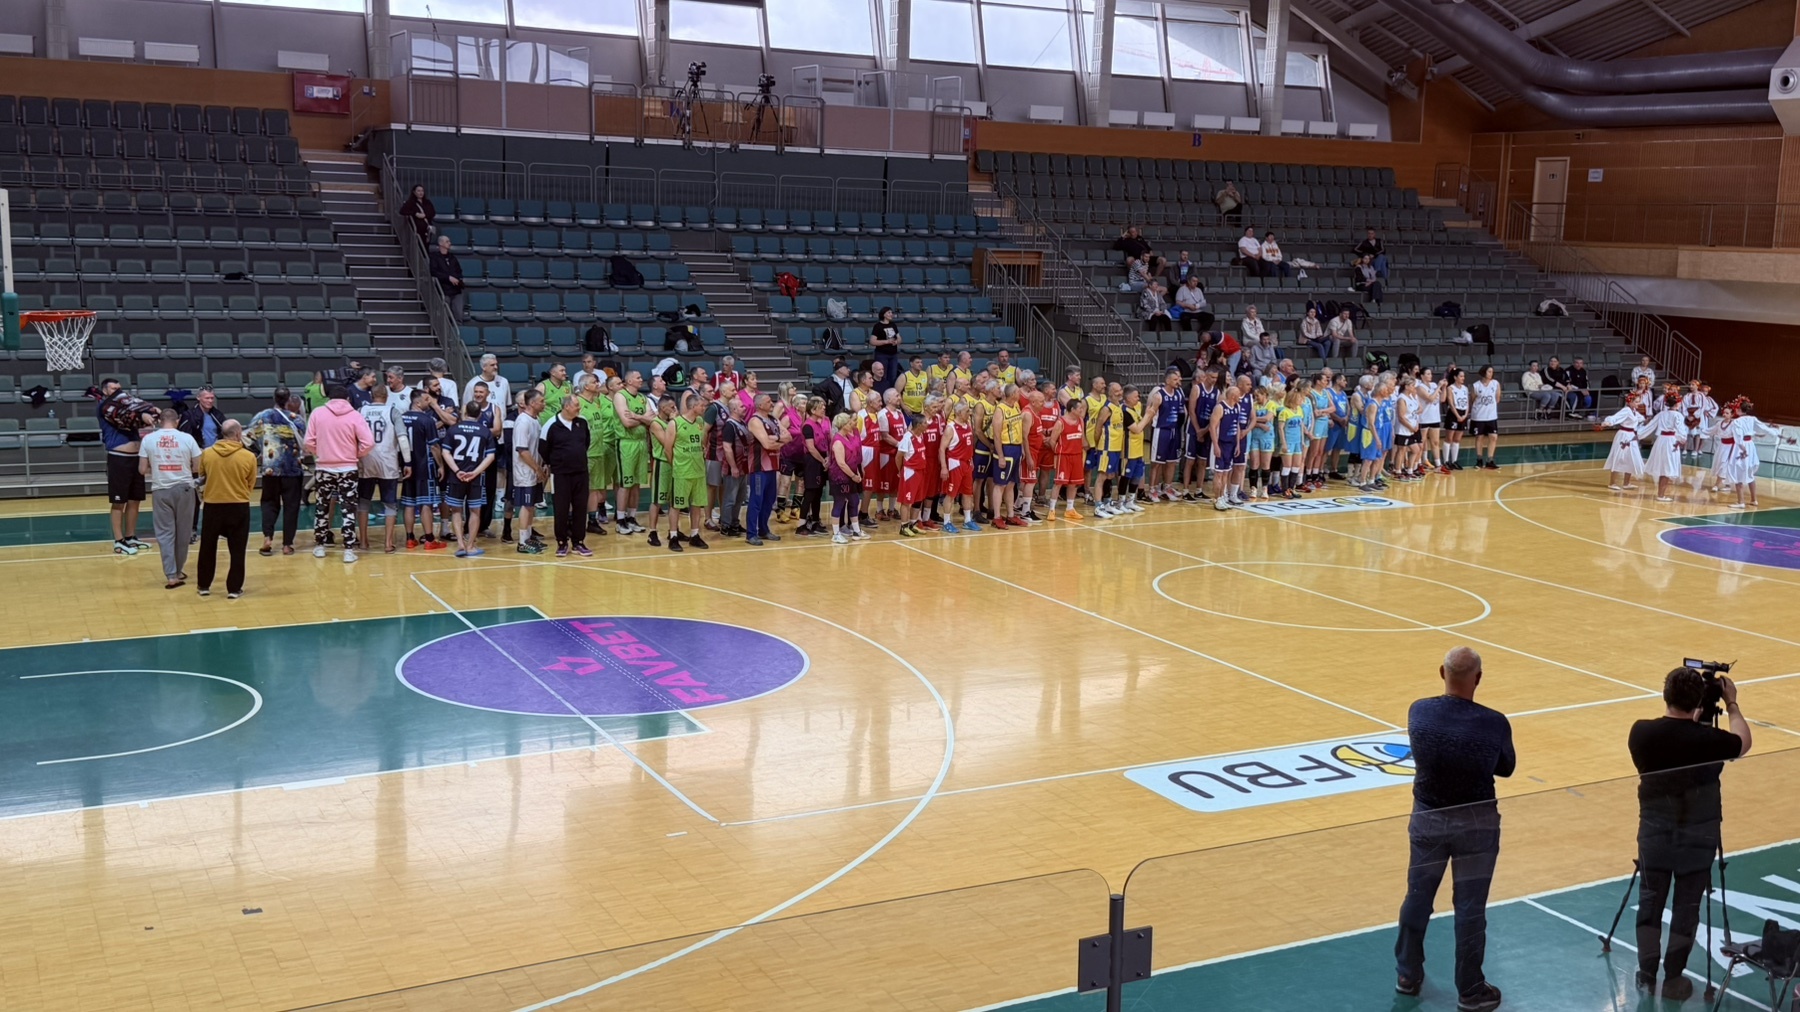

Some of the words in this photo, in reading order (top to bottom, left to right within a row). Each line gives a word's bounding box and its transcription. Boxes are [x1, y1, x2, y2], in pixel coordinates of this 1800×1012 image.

[635, 406, 644, 415] 23
[593, 411, 600, 420] 10
[690, 434, 700, 443] 69
[928, 433, 936, 442] 10
[454, 435, 481, 462] 24
[624, 475, 634, 485] 23
[1000, 471, 1006, 480] 6
[865, 478, 873, 488] 11
[881, 482, 890, 491] 13
[525, 493, 531, 504] 11
[906, 491, 911, 500] 4
[675, 496, 685, 505] 69
[1250, 499, 1344, 514] FBU
[568, 620, 729, 704] FAVBET
[1167, 754, 1357, 800] FBU
